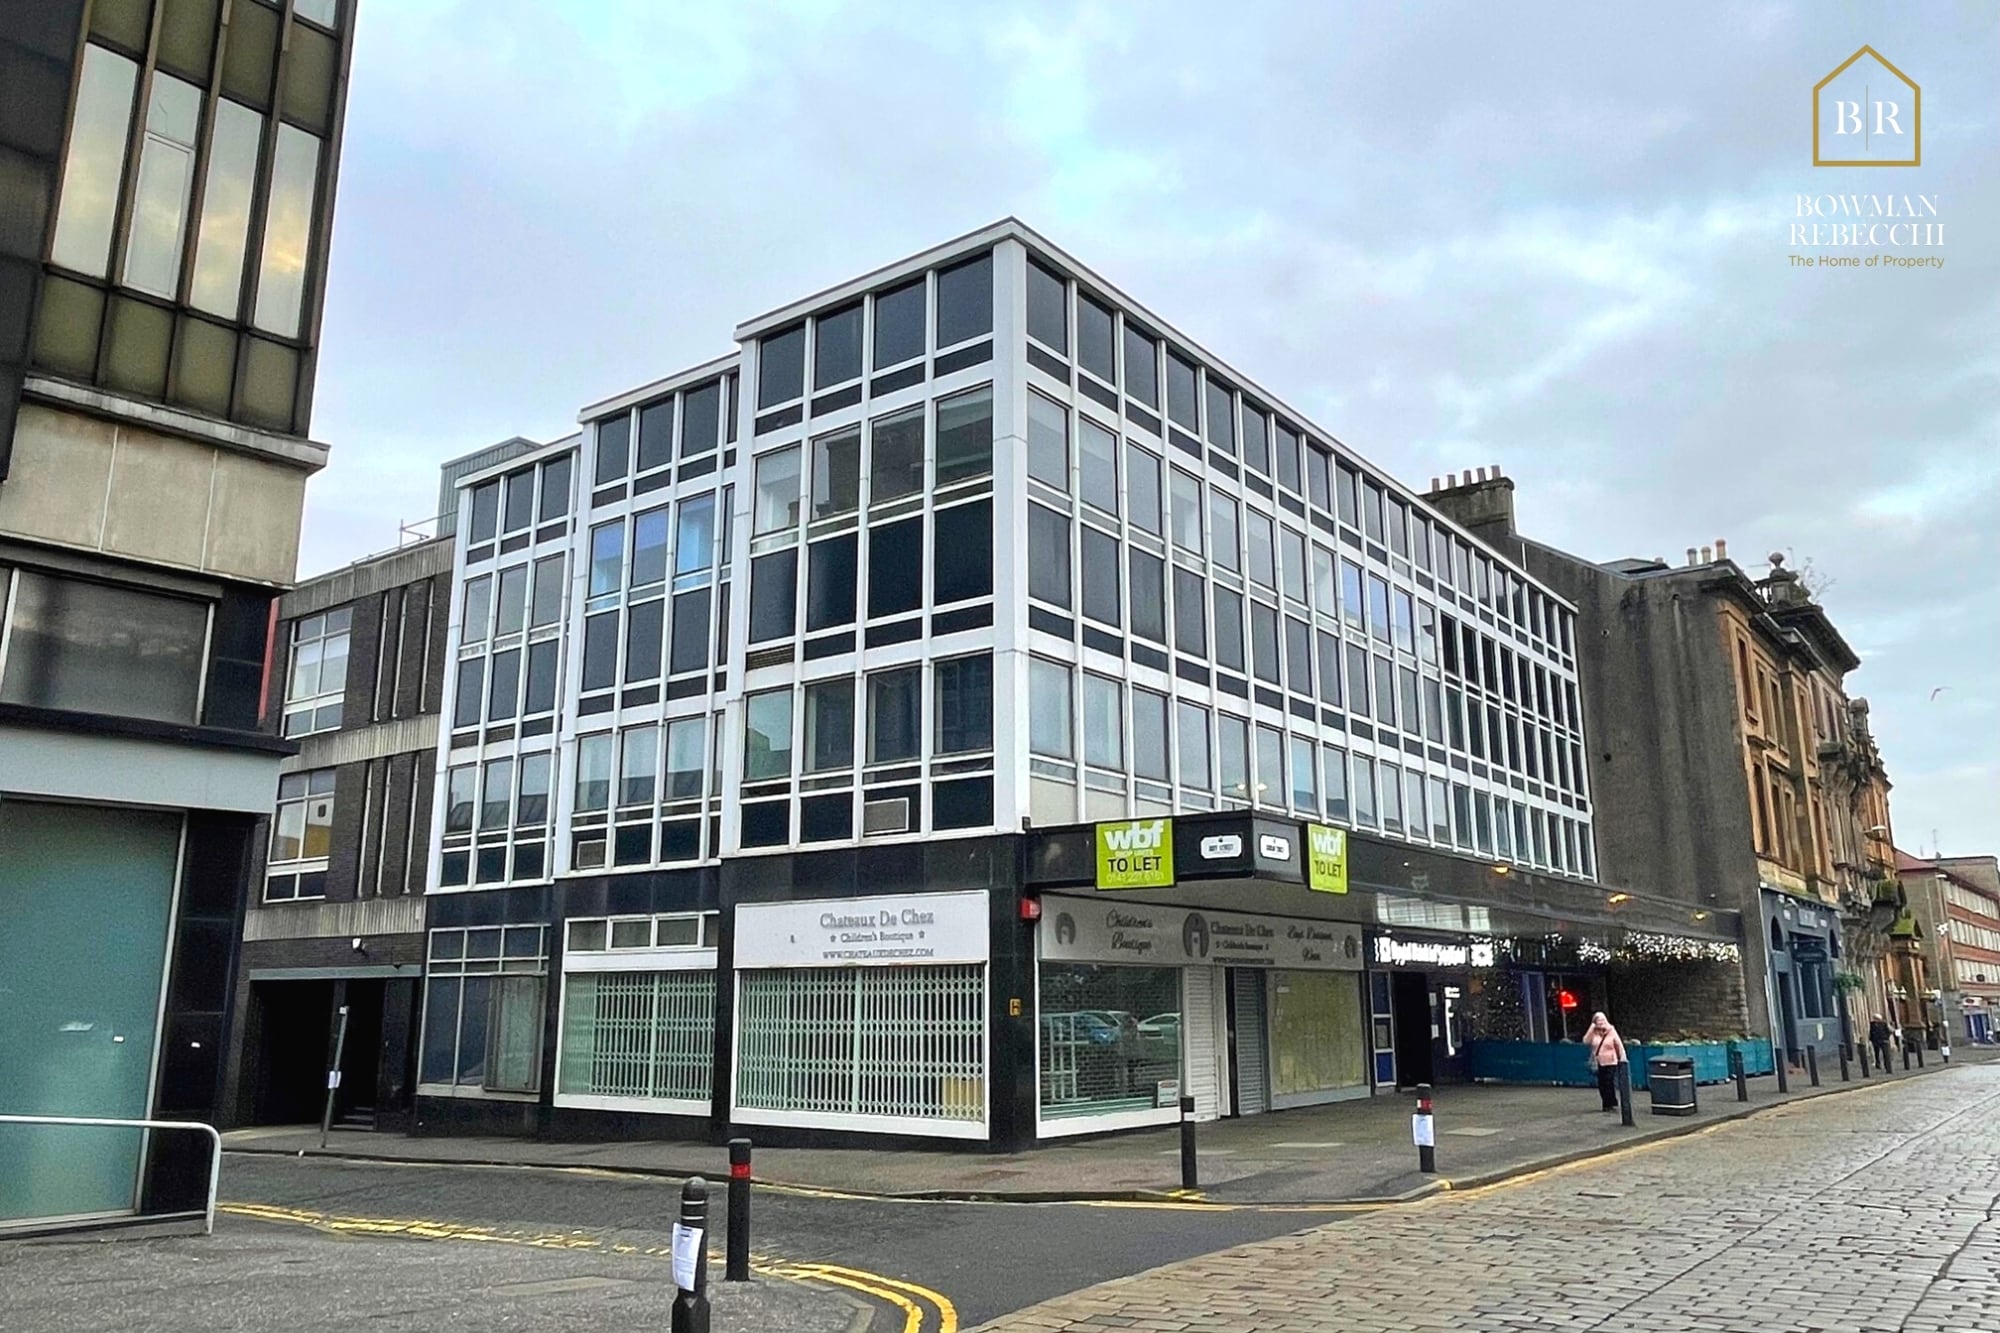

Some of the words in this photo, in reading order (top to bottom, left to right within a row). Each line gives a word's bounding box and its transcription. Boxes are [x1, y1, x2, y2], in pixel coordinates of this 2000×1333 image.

[1104, 820, 1164, 850] wbf
[1312, 828, 1342, 856] wbf
[1107, 857, 1128, 872] TO
[1133, 856, 1162, 871] LET
[1314, 860, 1326, 875] TO
[1328, 862, 1341, 878] LET
[820, 912, 876, 928] Chateaux
[880, 910, 897, 926] De
[901, 908, 934, 925] Chez
